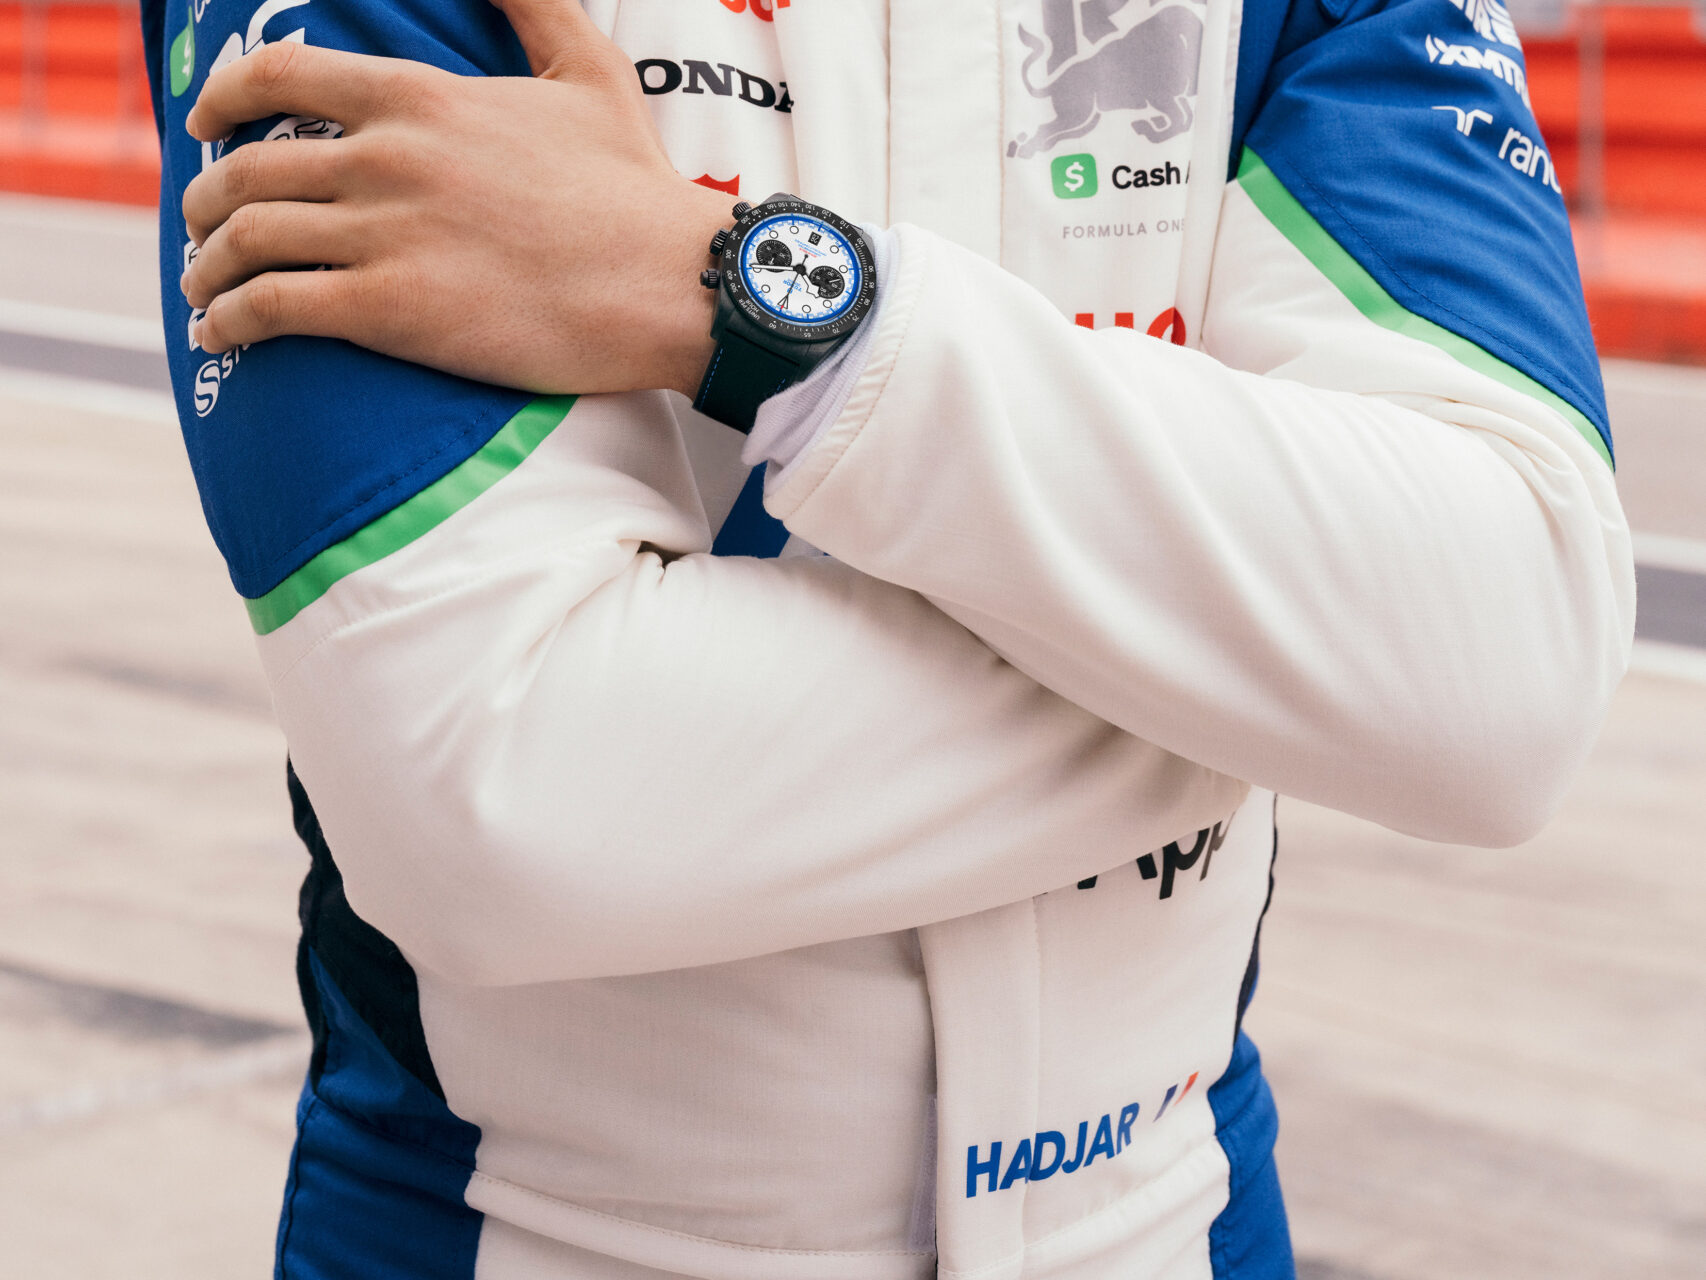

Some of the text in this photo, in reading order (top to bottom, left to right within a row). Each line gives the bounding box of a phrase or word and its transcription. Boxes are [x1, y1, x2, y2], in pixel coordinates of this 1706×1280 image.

[634, 58, 795, 114] ONDA
[1111, 161, 1181, 190] Cash
[1063, 221, 1148, 240] FORMULA
[966, 1102, 1140, 1199] HADJAR
